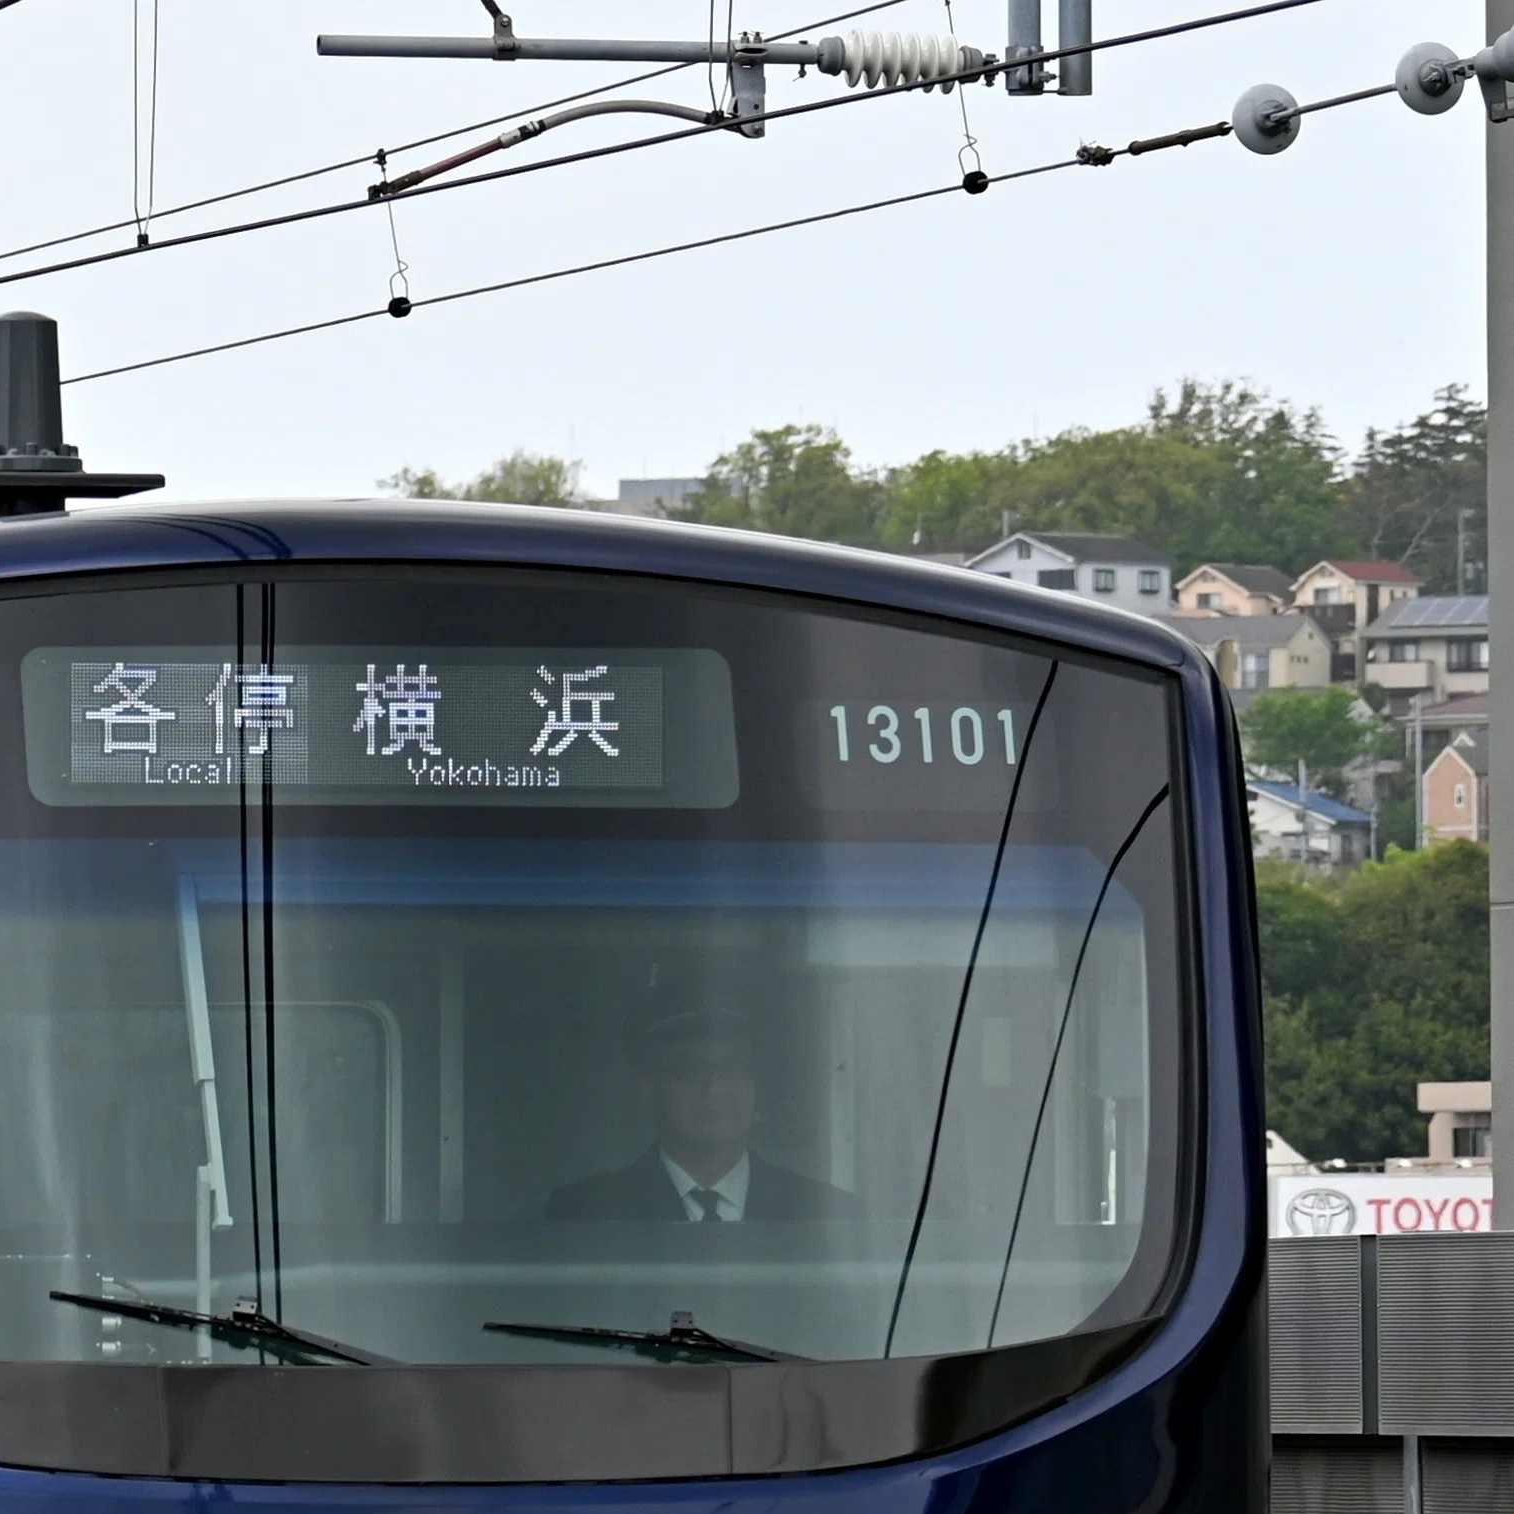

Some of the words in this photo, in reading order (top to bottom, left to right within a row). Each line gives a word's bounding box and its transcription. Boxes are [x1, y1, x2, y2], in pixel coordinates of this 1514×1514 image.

[84, 662, 294, 755] 各停
[352, 663, 620, 757] 横浜
[829, 704, 1017, 766] 13101
[144, 756, 232, 785] Local
[407, 757, 561, 787] Yokohama
